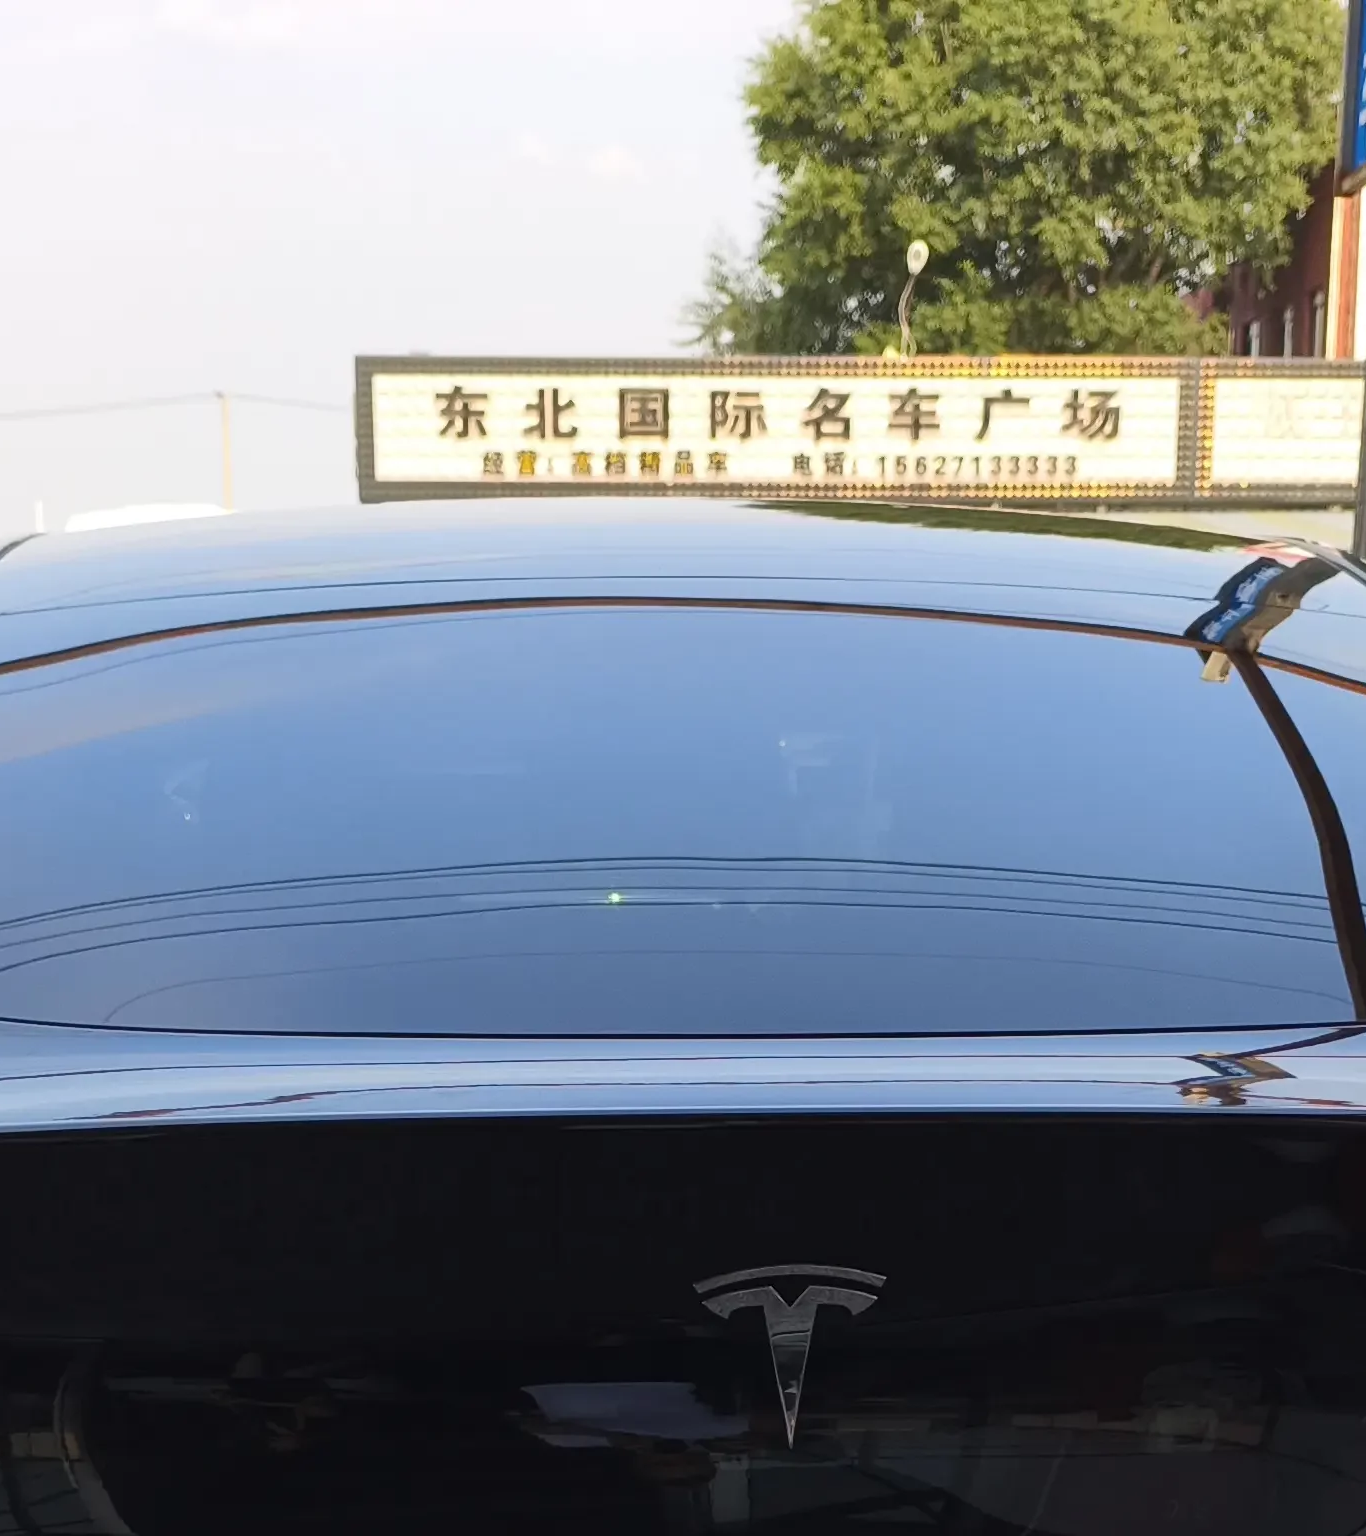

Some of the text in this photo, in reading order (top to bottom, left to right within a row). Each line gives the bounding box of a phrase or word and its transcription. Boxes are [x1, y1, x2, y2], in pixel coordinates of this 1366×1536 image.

[436, 385, 1120, 441] 东北国际名车广场
